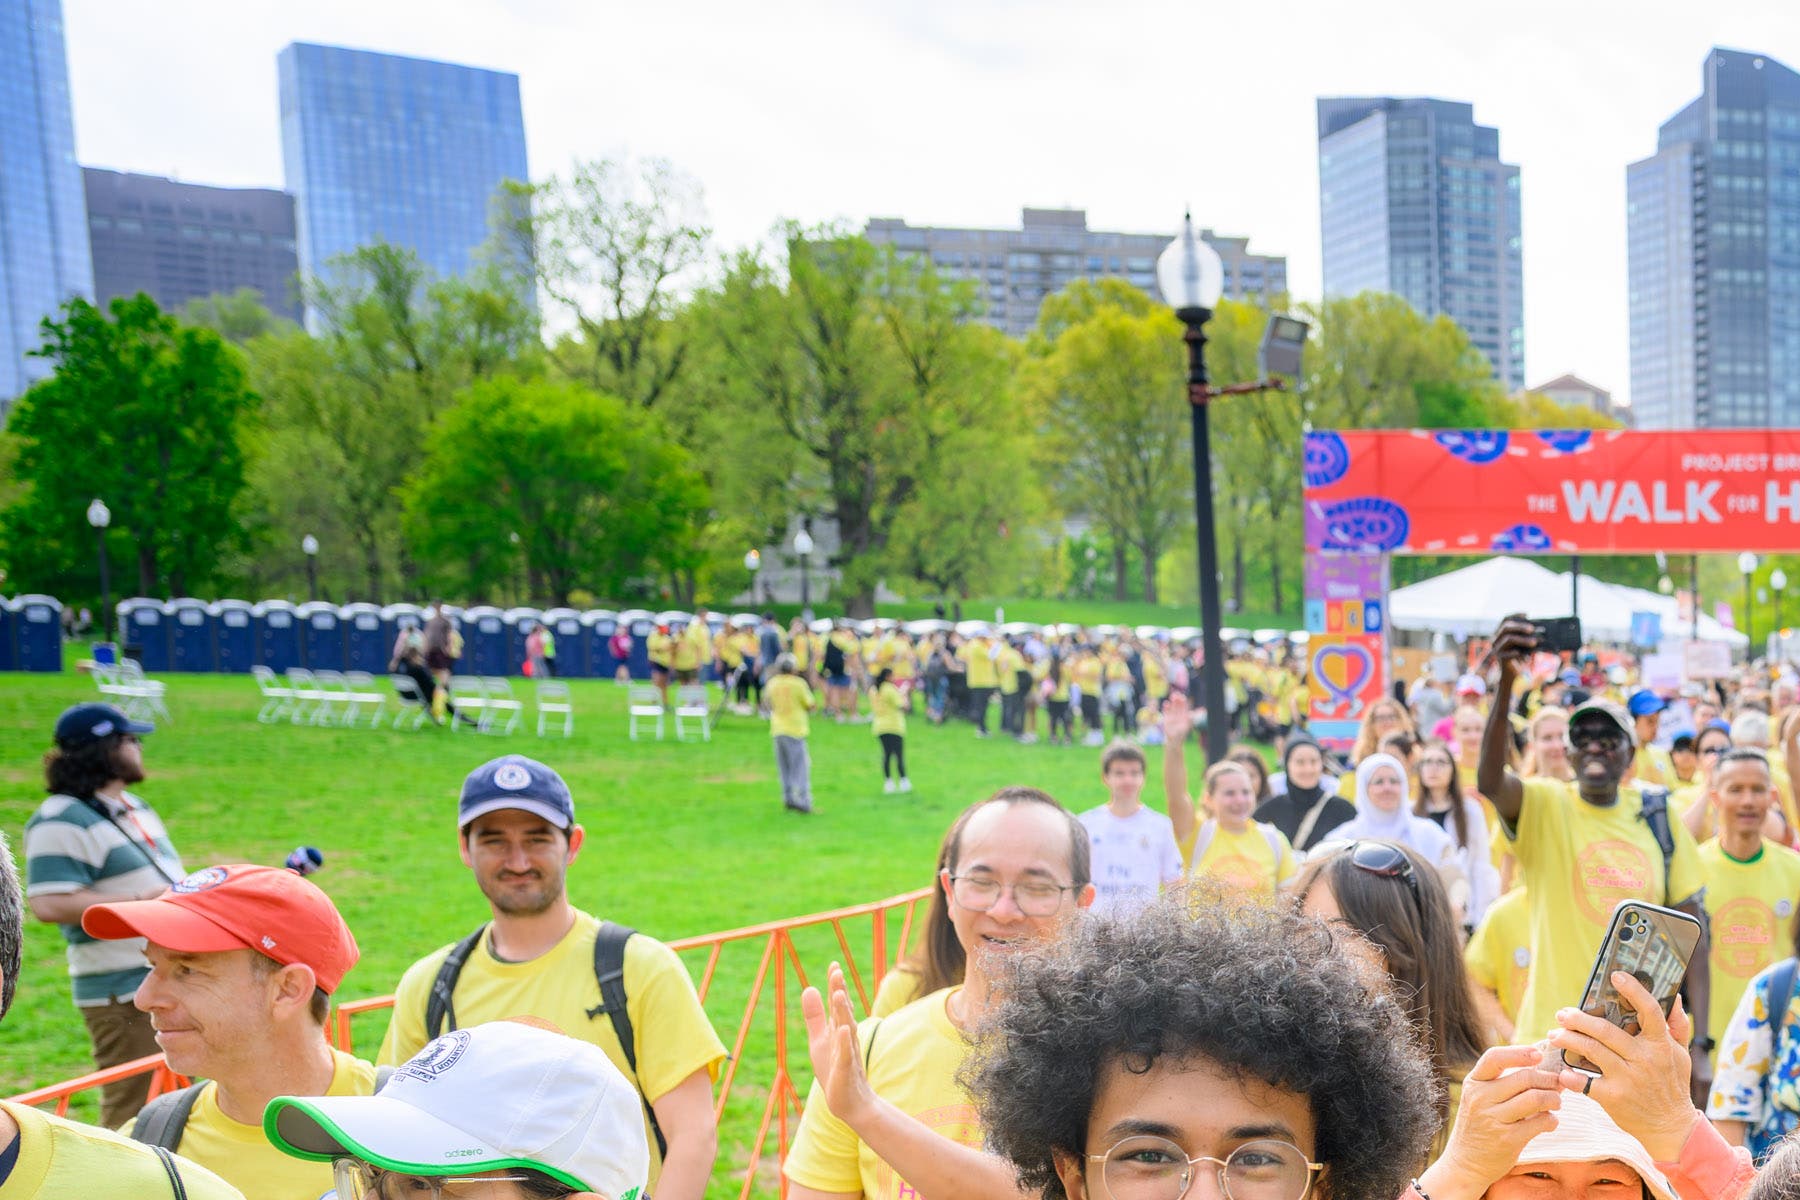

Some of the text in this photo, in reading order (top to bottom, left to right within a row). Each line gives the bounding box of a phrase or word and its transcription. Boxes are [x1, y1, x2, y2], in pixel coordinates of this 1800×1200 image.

[1682, 454, 1768, 472] PROJECT
[1528, 494, 1557, 513] THE
[1562, 480, 1723, 523] WALK
[1727, 495, 1759, 513] FOR
